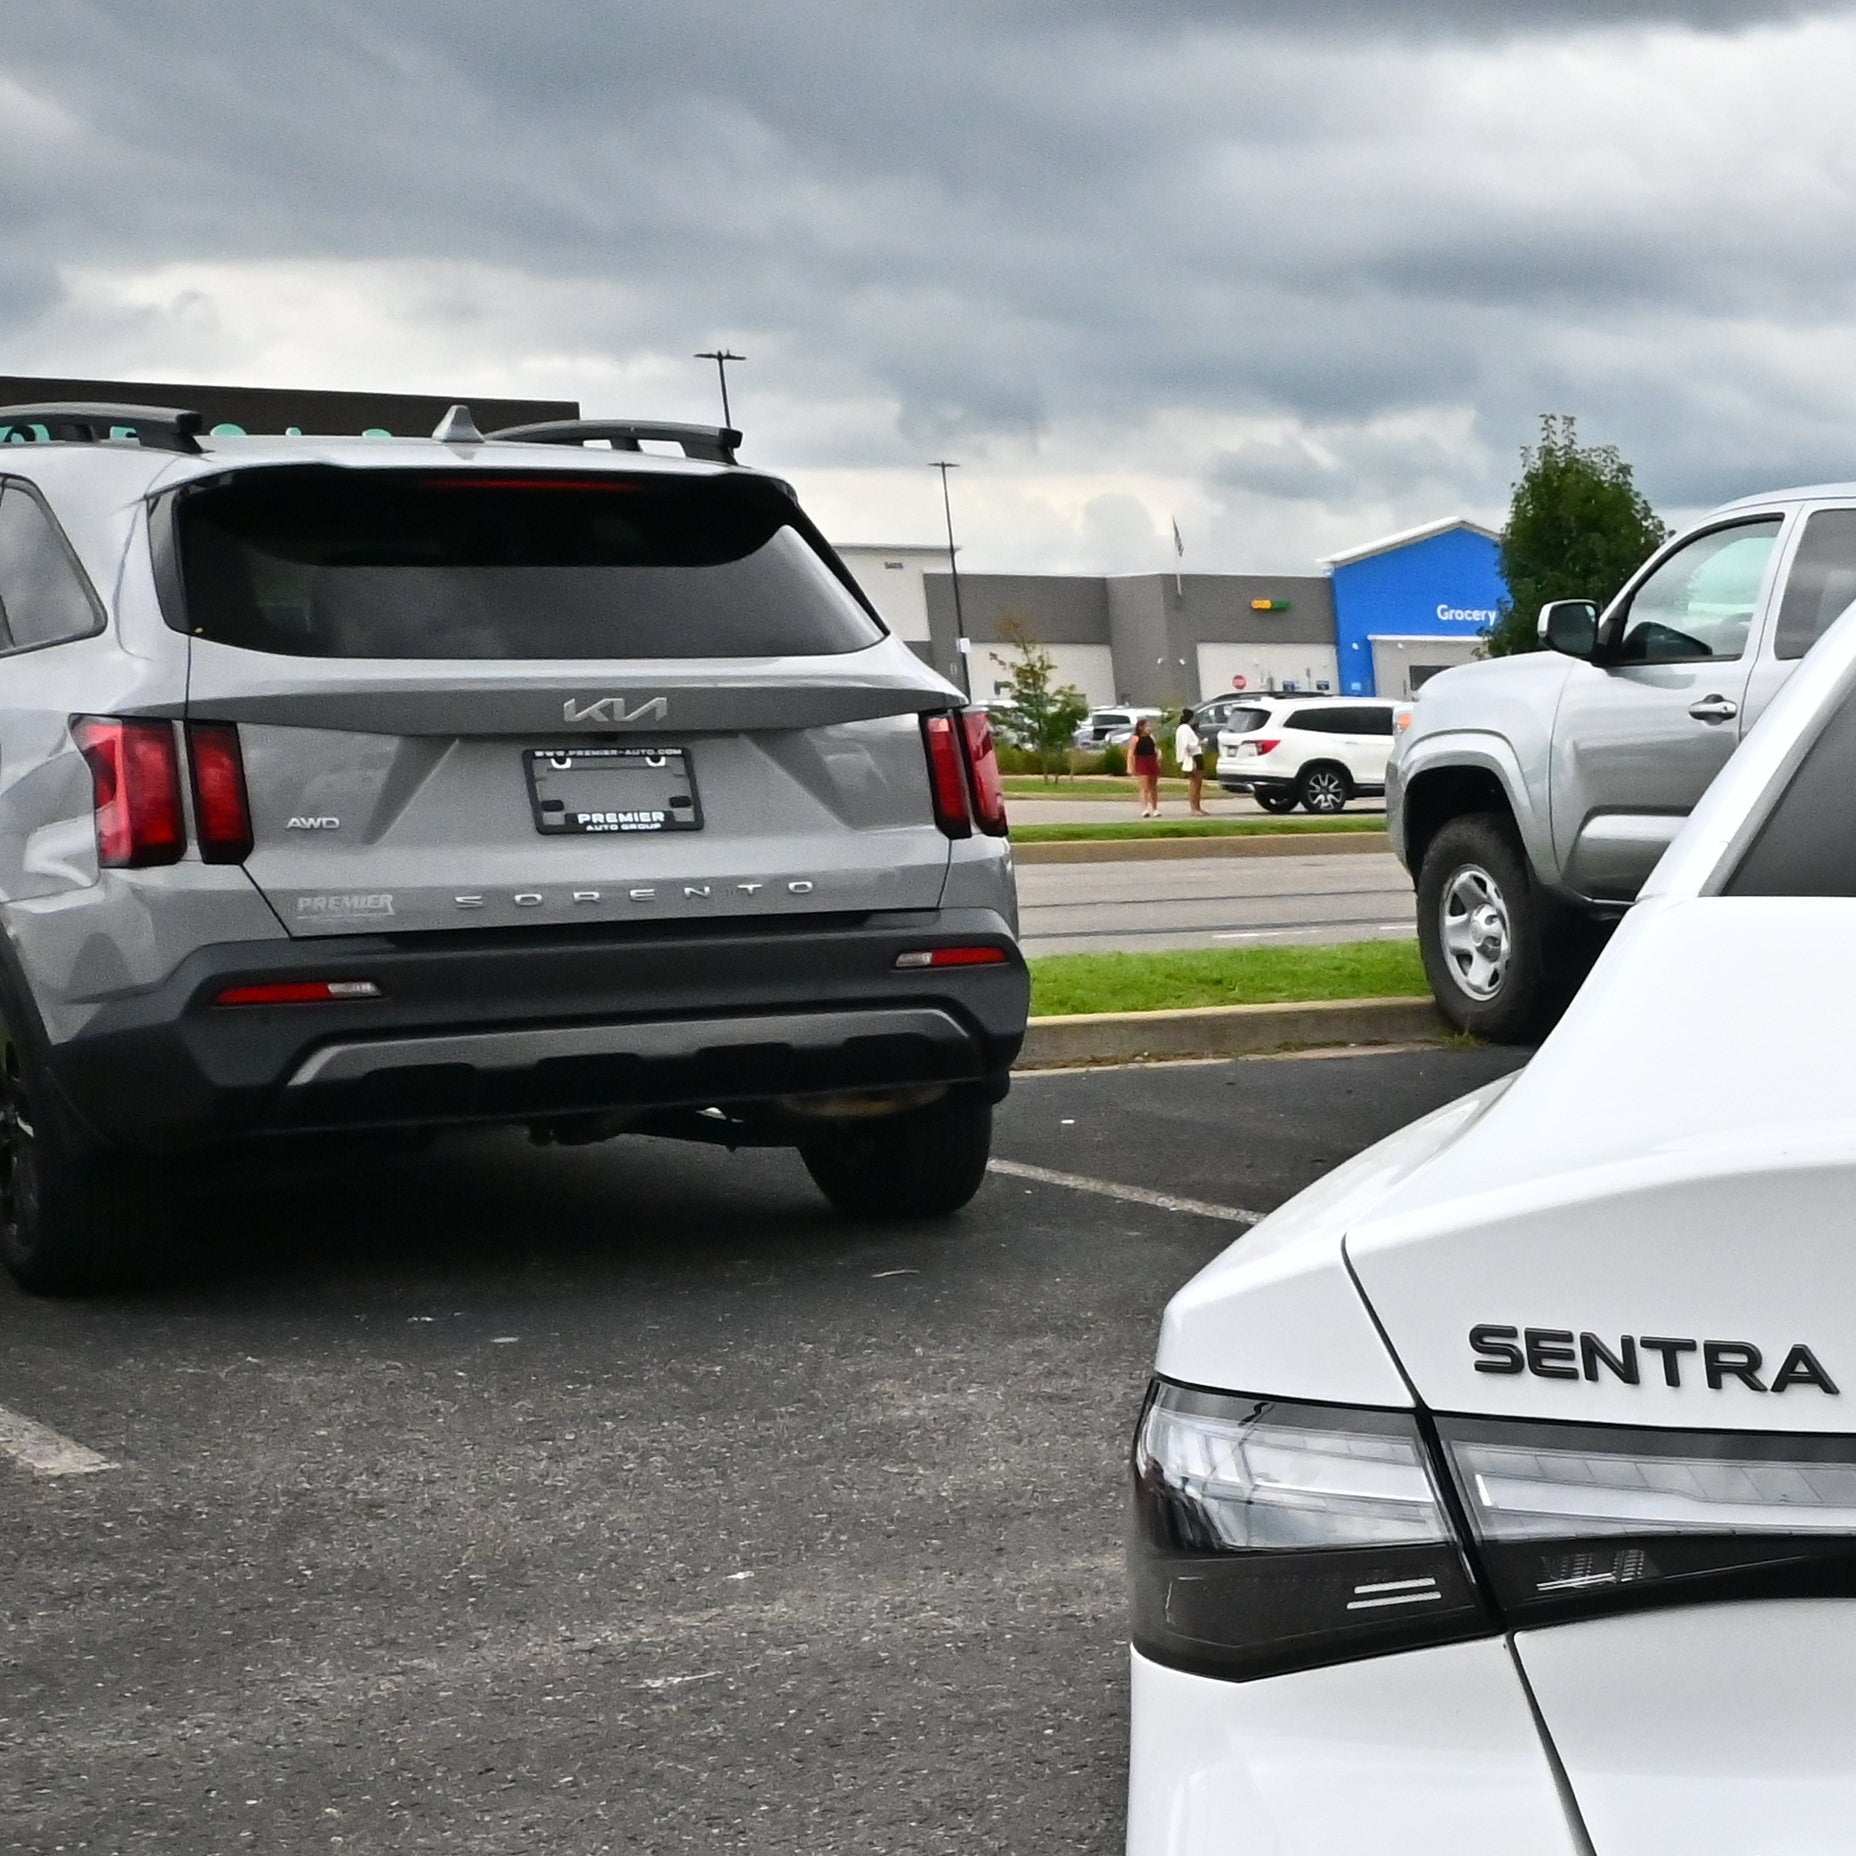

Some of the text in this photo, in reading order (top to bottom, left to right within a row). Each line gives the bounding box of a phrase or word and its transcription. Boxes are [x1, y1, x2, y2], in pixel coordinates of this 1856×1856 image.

[1437, 604, 1496, 626] Grocery
[563, 697, 668, 722] KIA
[534, 749, 683, 757] WWW.PREMIER-AUTO.COM
[286, 817, 340, 830] AWD
[577, 811, 665, 824] PREMIER
[586, 823, 662, 831] AUTO GROUP
[298, 894, 394, 914] PREMIER
[455, 880, 814, 909] SORENTO
[1468, 1323, 1840, 1395] SENTRA
